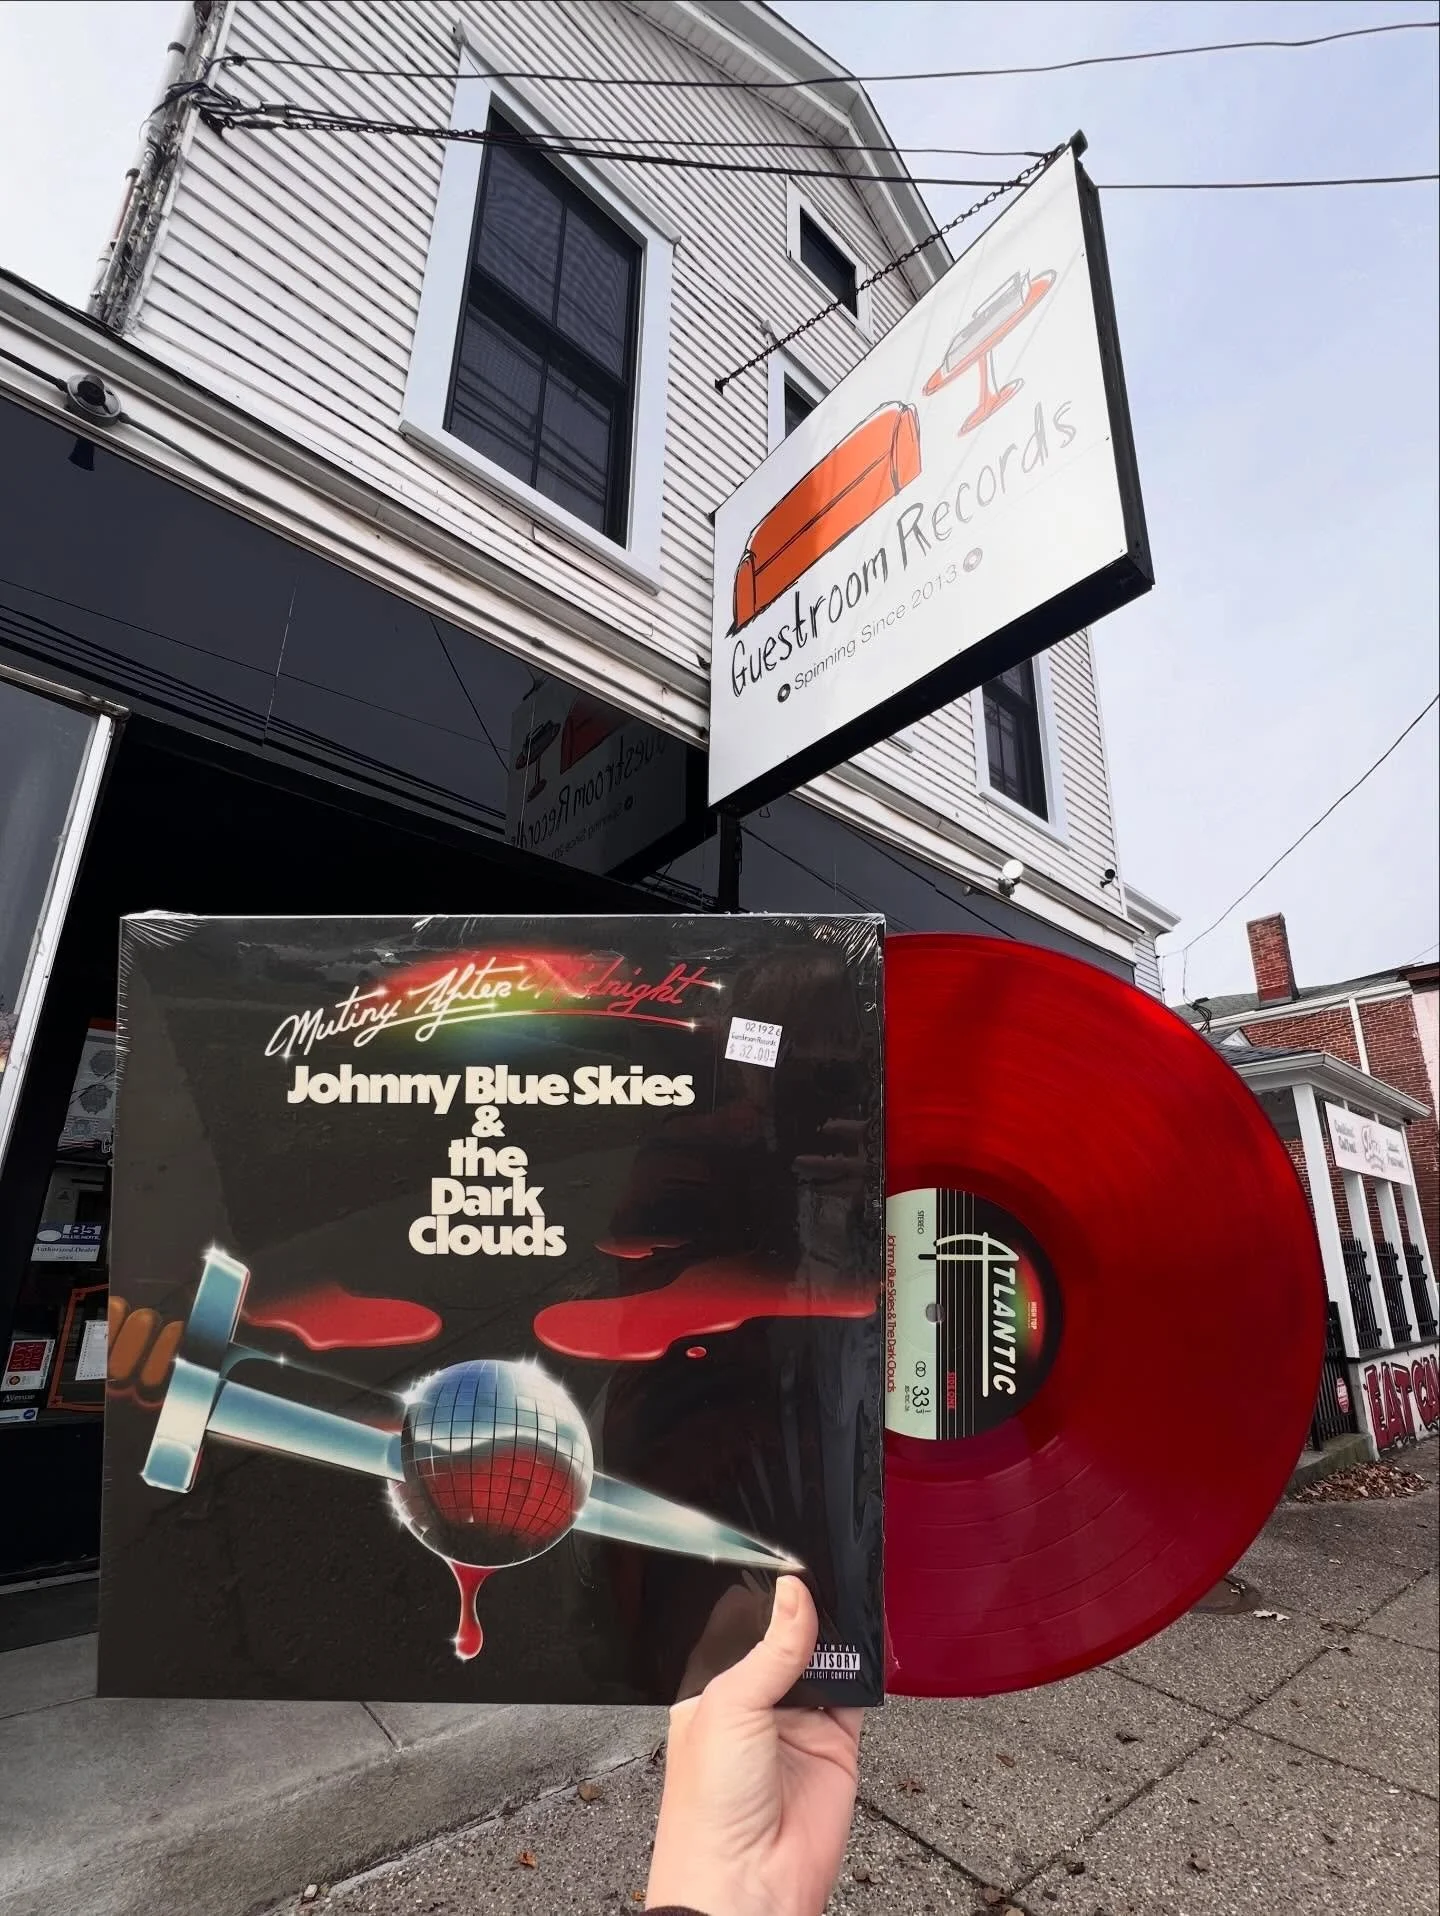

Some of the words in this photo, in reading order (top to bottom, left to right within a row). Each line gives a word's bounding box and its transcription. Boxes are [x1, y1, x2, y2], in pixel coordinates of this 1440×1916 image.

[732, 547, 888, 698] Guestroom
[896, 400, 1077, 571] Records
[794, 640, 857, 690] Spinning
[860, 604, 906, 644] Since
[911, 564, 957, 609] 2013
[265, 985, 402, 1060] Mutiny
[406, 956, 524, 1041] After
[520, 955, 722, 1016] Midnight
[287, 1064, 460, 1114] Johnny
[465, 1064, 568, 1106] Blue
[573, 1065, 695, 1106] Skies
[471, 1104, 506, 1138] &
[447, 1136, 528, 1178] the
[431, 1176, 545, 1216] Dark
[408, 1214, 568, 1256] Clouds
[917, 1209, 925, 1235] STEREO
[886, 1234, 897, 1267] Johnny
[886, 1268, 897, 1288] Blue
[886, 1289, 897, 1311] Skies
[886, 1312, 897, 1320] &
[918, 1231, 1019, 1398] ATLANTIC
[886, 1321, 897, 1339] The
[886, 1339, 897, 1360] Dark
[886, 1361, 897, 1393] Clouds
[1364, 1361, 1417, 1451] EAT
[808, 1653, 857, 1669] DVISORY
[816, 1643, 857, 1653] RENTAL
[830, 1671, 857, 1680] CONTENT
